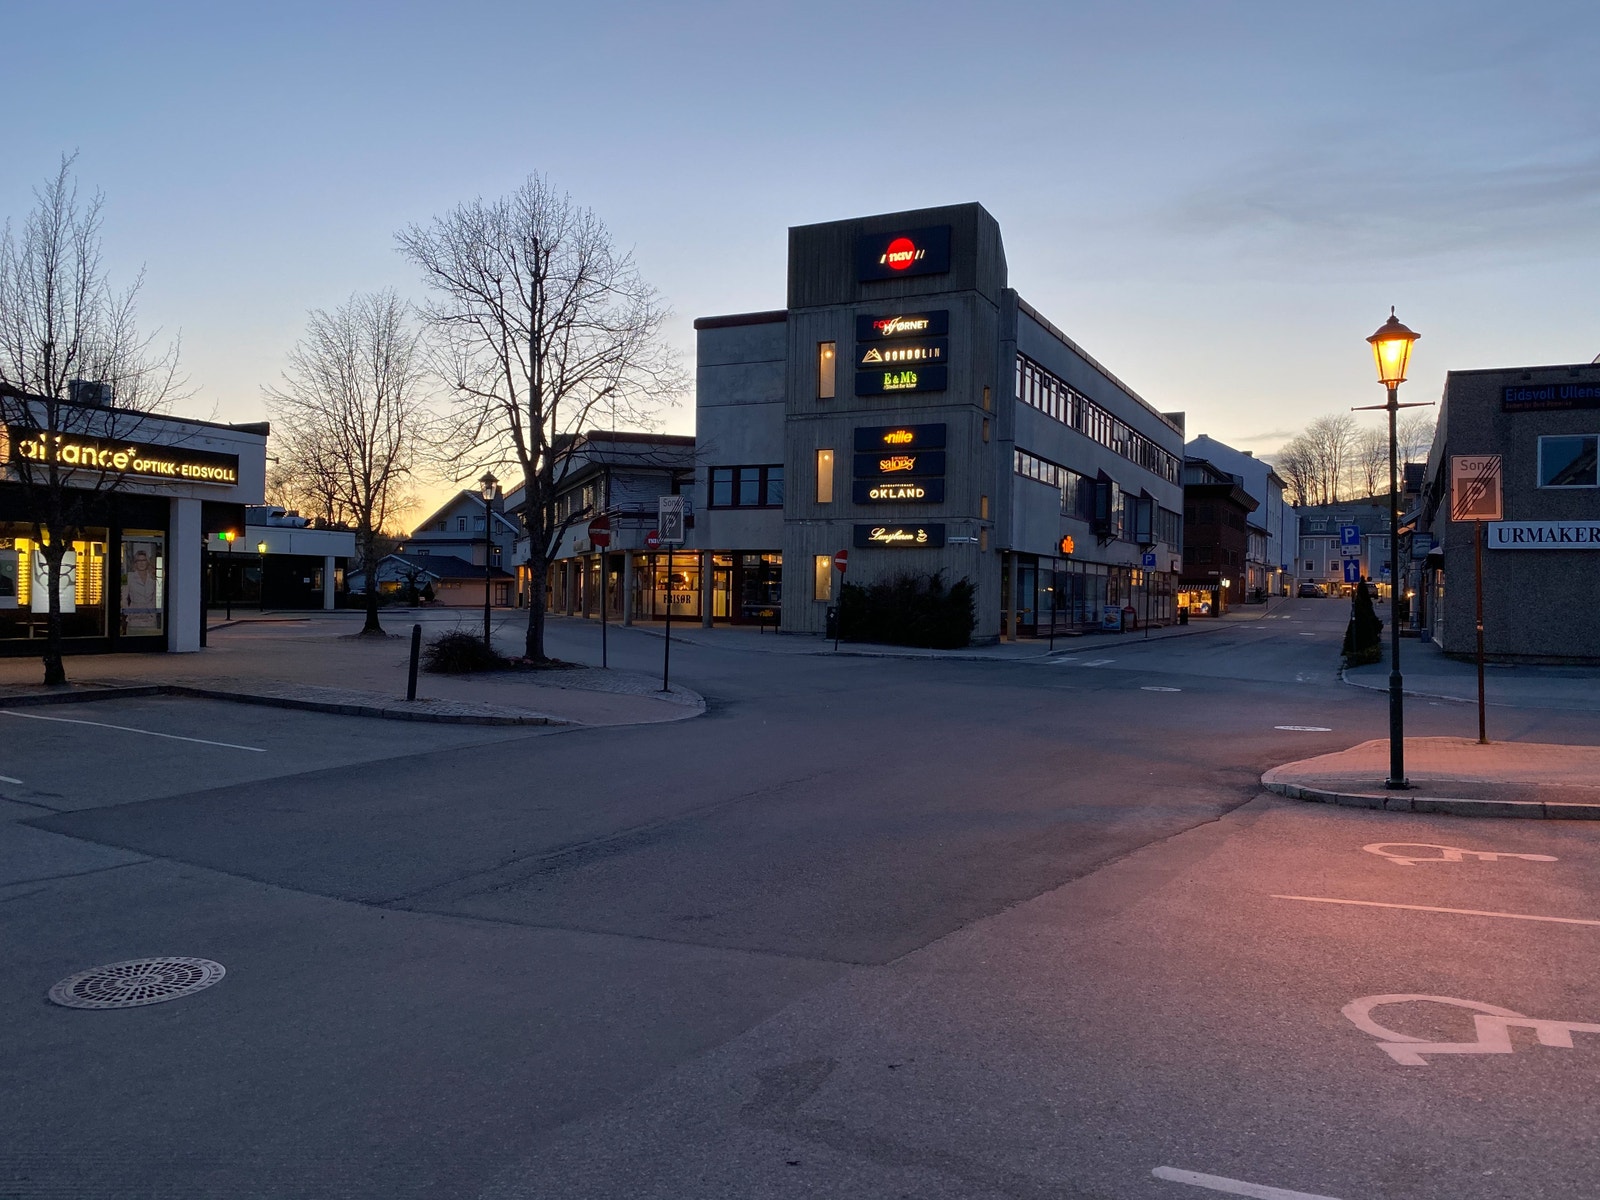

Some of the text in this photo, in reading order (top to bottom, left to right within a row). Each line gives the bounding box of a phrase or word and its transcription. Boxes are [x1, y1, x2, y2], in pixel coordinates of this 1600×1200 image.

[884, 348, 940, 361] GONDOLIN
[1505, 387, 1555, 402] Eidsvoll
[886, 430, 913, 443] nille
[18, 433, 236, 481] aliance OPTIKK EIDSVOLL
[1344, 528, 1355, 543] P
[1497, 526, 1600, 544] URMAKER
[1145, 556, 1153, 565] P
